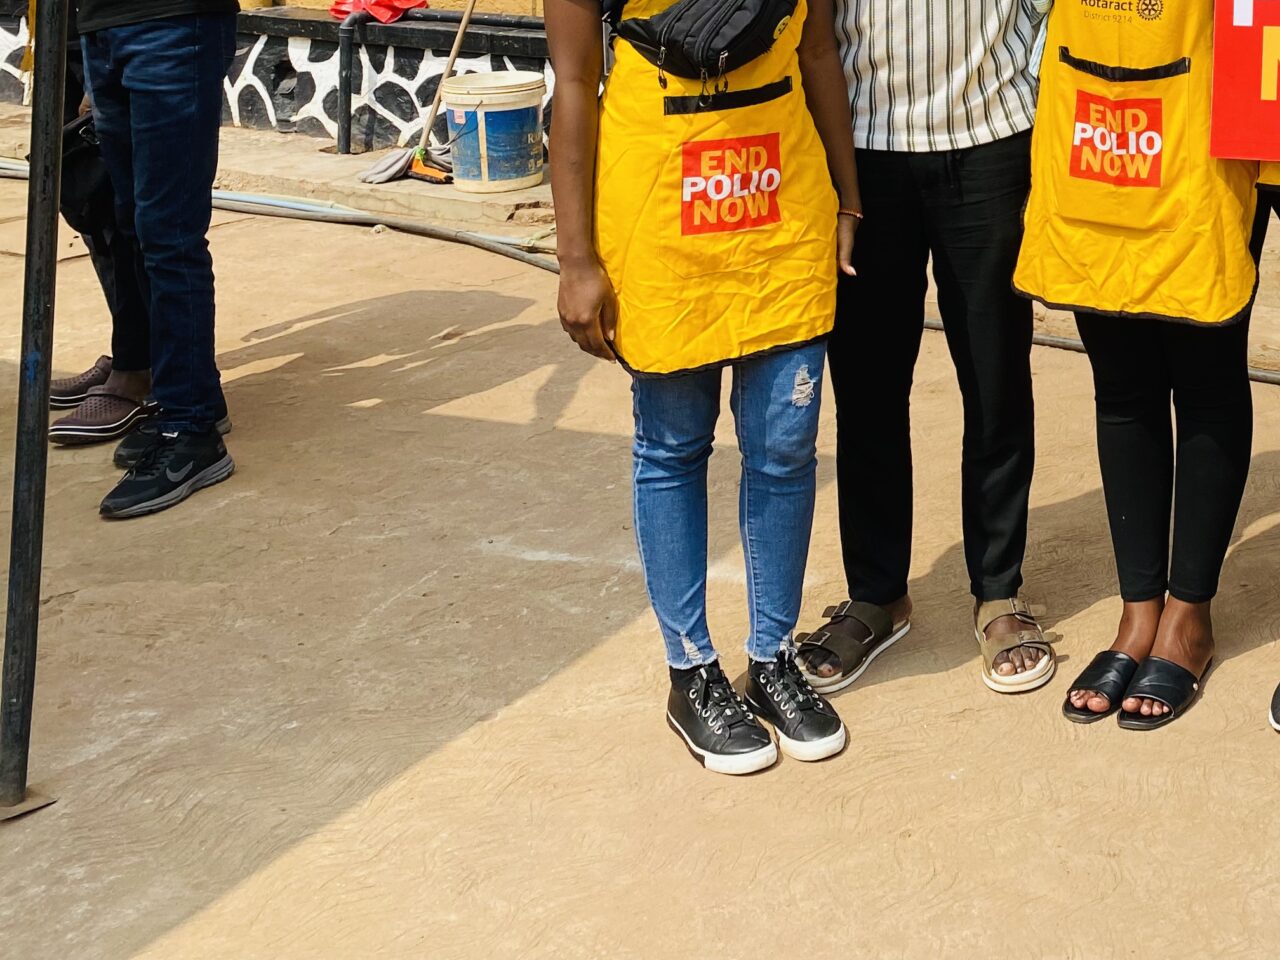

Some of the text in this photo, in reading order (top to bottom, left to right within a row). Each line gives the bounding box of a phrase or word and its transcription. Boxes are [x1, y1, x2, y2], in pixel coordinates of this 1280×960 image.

[1089, 102, 1148, 134] END
[1073, 122, 1163, 156] POLIO
[700, 145, 768, 177] END
[1080, 145, 1154, 179] NOW
[682, 168, 781, 202] POLIO
[693, 191, 769, 226] NOW
